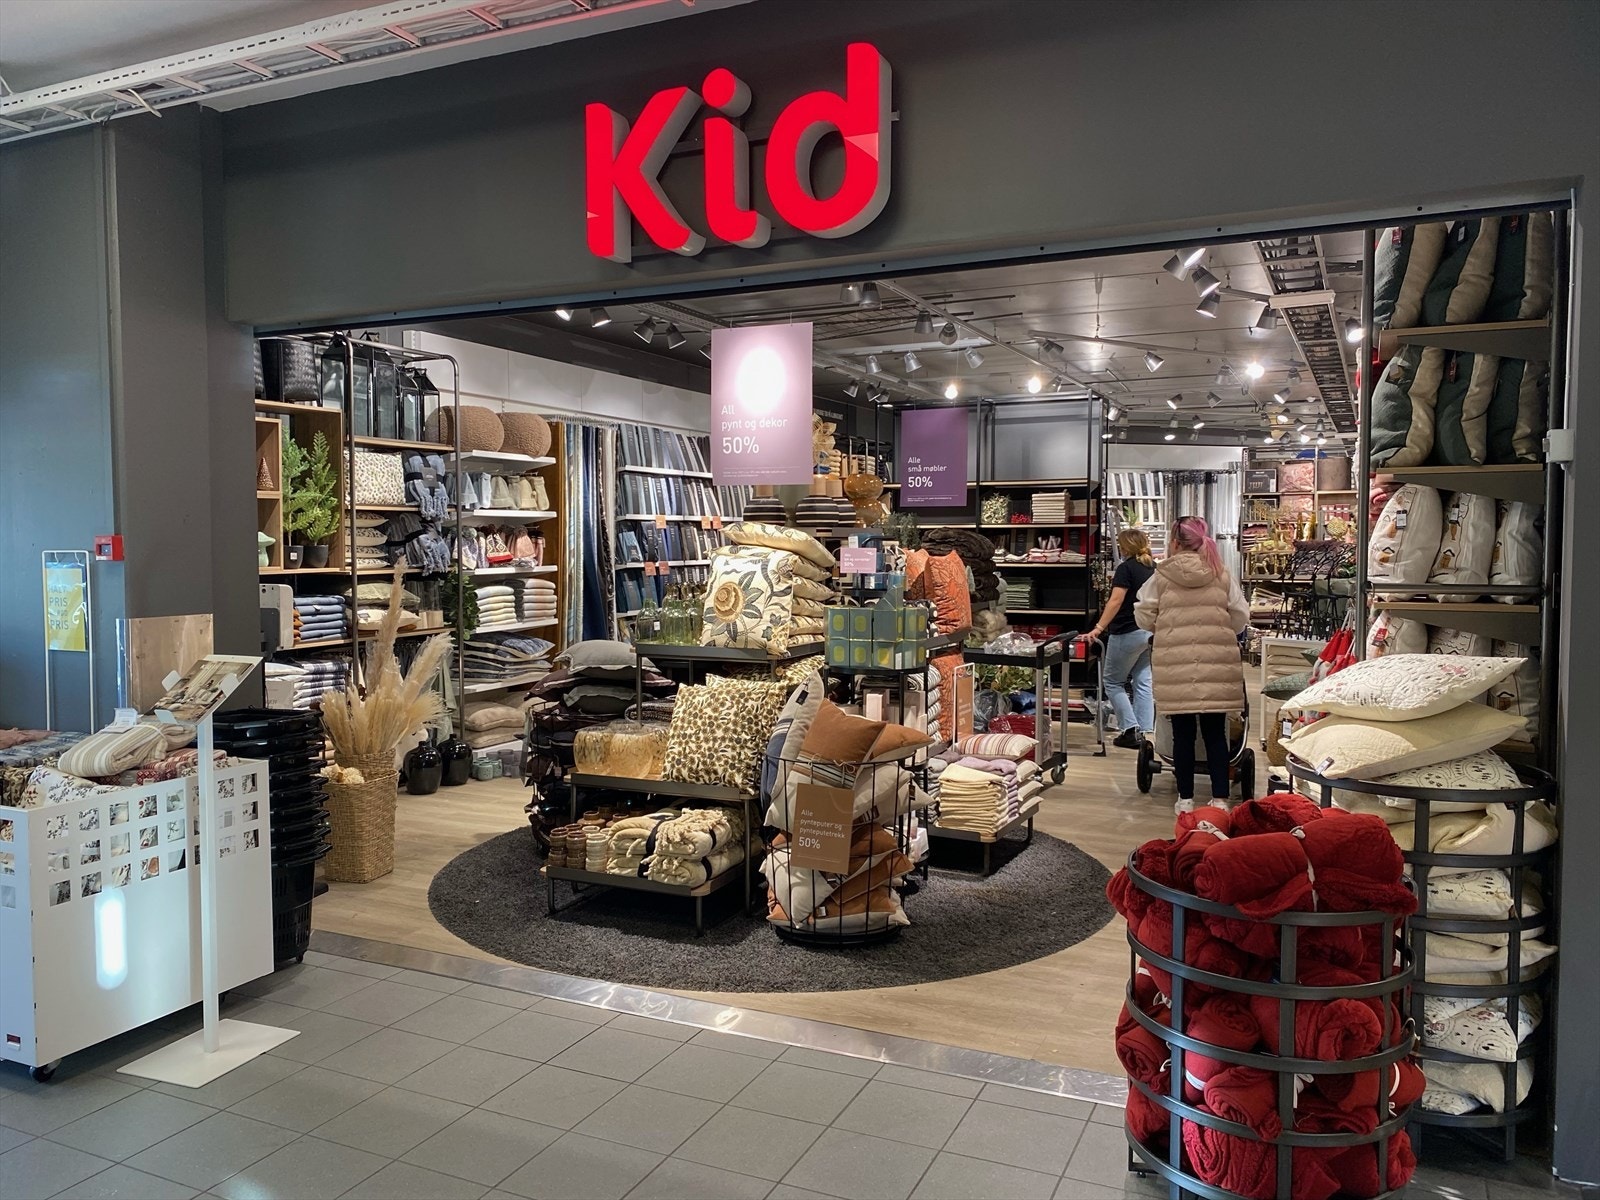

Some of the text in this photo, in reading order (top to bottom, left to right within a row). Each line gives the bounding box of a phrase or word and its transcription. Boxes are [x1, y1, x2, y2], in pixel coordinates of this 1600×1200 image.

[585, 42, 888, 261] Kid
[721, 405, 735, 415] All
[721, 417, 788, 432] pynt og dekor
[722, 436, 760, 454] 50%
[907, 464, 948, 473] små møbler
[907, 476, 933, 488] 50%
[49, 597, 68, 607] PRIS
[50, 620, 69, 630] PRIS
[801, 809, 814, 817] Alle
[800, 818, 843, 831] pynteputer og
[798, 836, 821, 849] 50%
